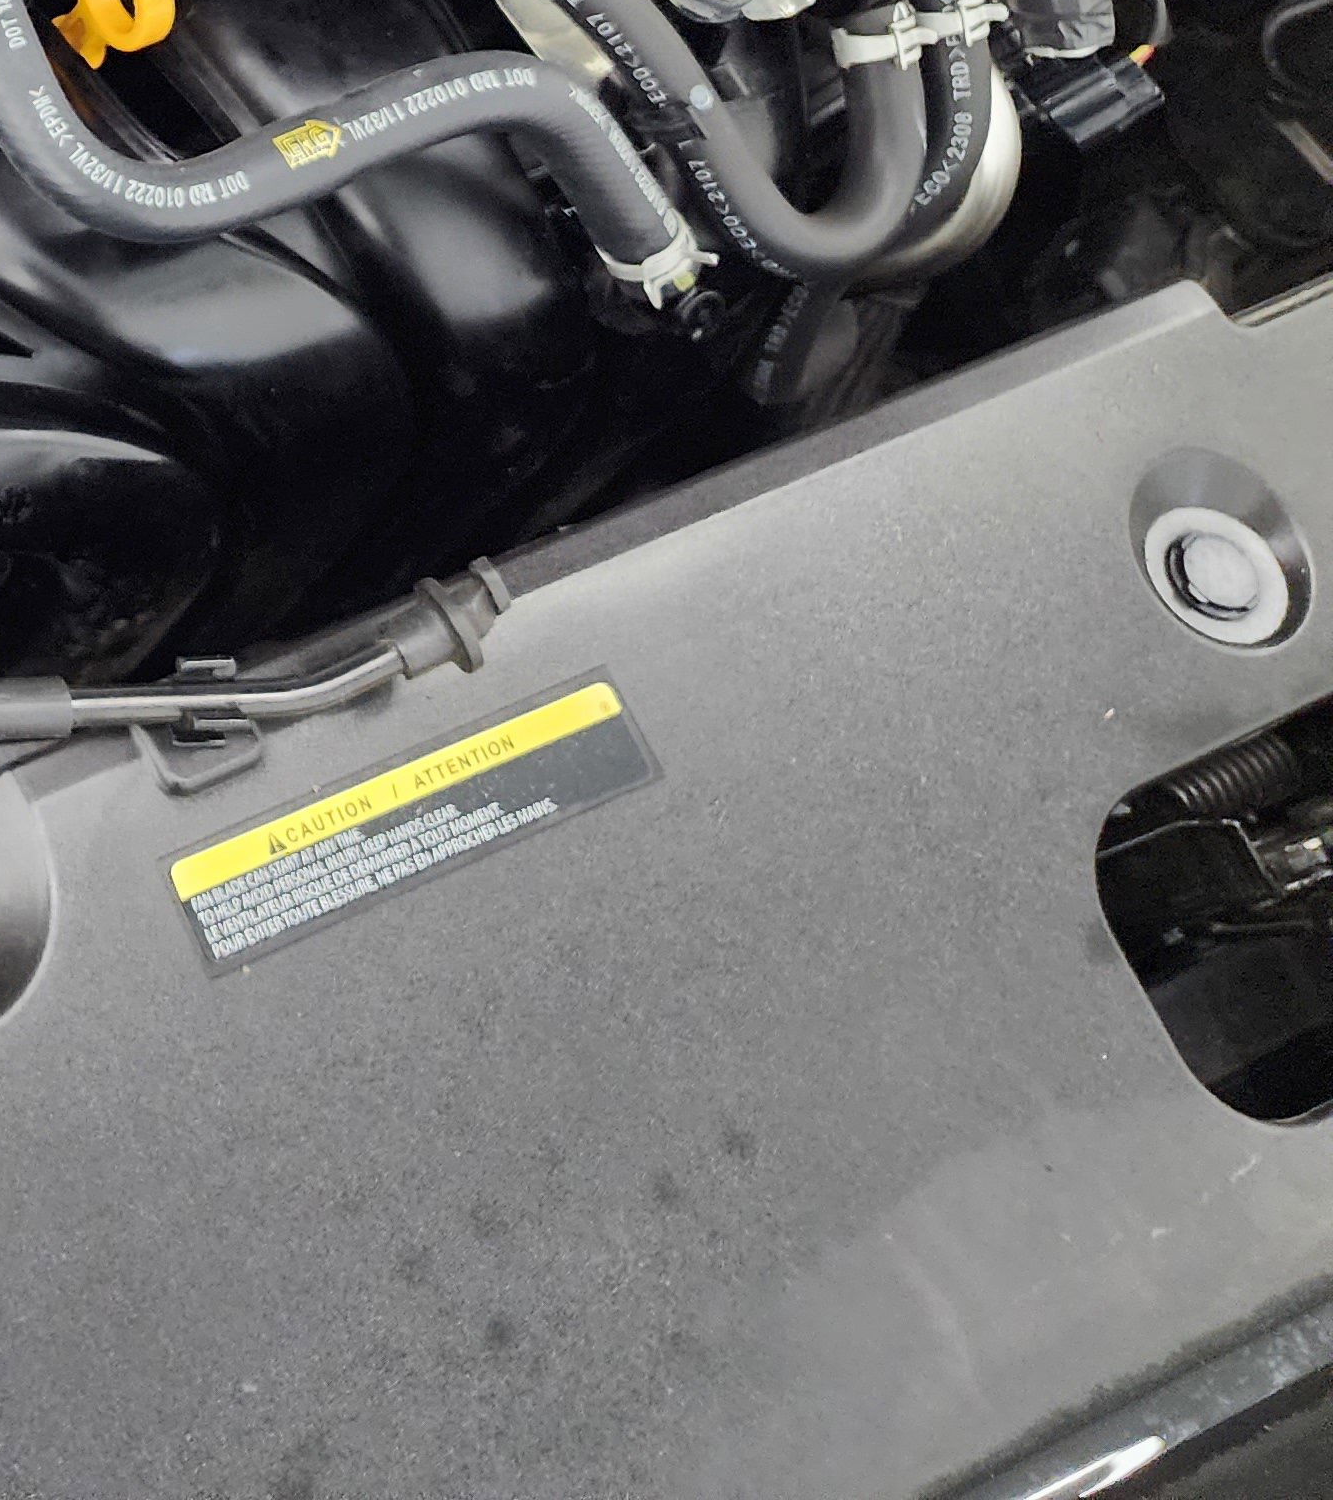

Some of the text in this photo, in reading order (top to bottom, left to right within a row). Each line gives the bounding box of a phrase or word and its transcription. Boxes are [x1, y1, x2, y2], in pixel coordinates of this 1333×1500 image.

[502, 67, 537, 87] DOT
[28, 84, 74, 145] >EPDM<
[402, 77, 466, 117] 010222
[123, 178, 184, 207] 010222
[217, 170, 249, 198] DOT
[284, 794, 373, 844] CAUTION
[411, 733, 514, 790] ATTENTION
[195, 907, 217, 929] TO
[212, 896, 243, 922] HELP
[238, 881, 276, 910] AVOID
[271, 858, 328, 895] PERSONAL
[359, 831, 391, 856] KEEP
[385, 816, 426, 844] HANDS
[267, 851, 303, 878] START
[209, 930, 248, 961] POUR
[280, 897, 323, 929] TOUTE
[390, 855, 418, 880] PAS
[428, 820, 500, 863] APPROCHER
[494, 811, 520, 834] LES
[290, 873, 336, 905] RISQUE
[330, 866, 353, 887] DE
